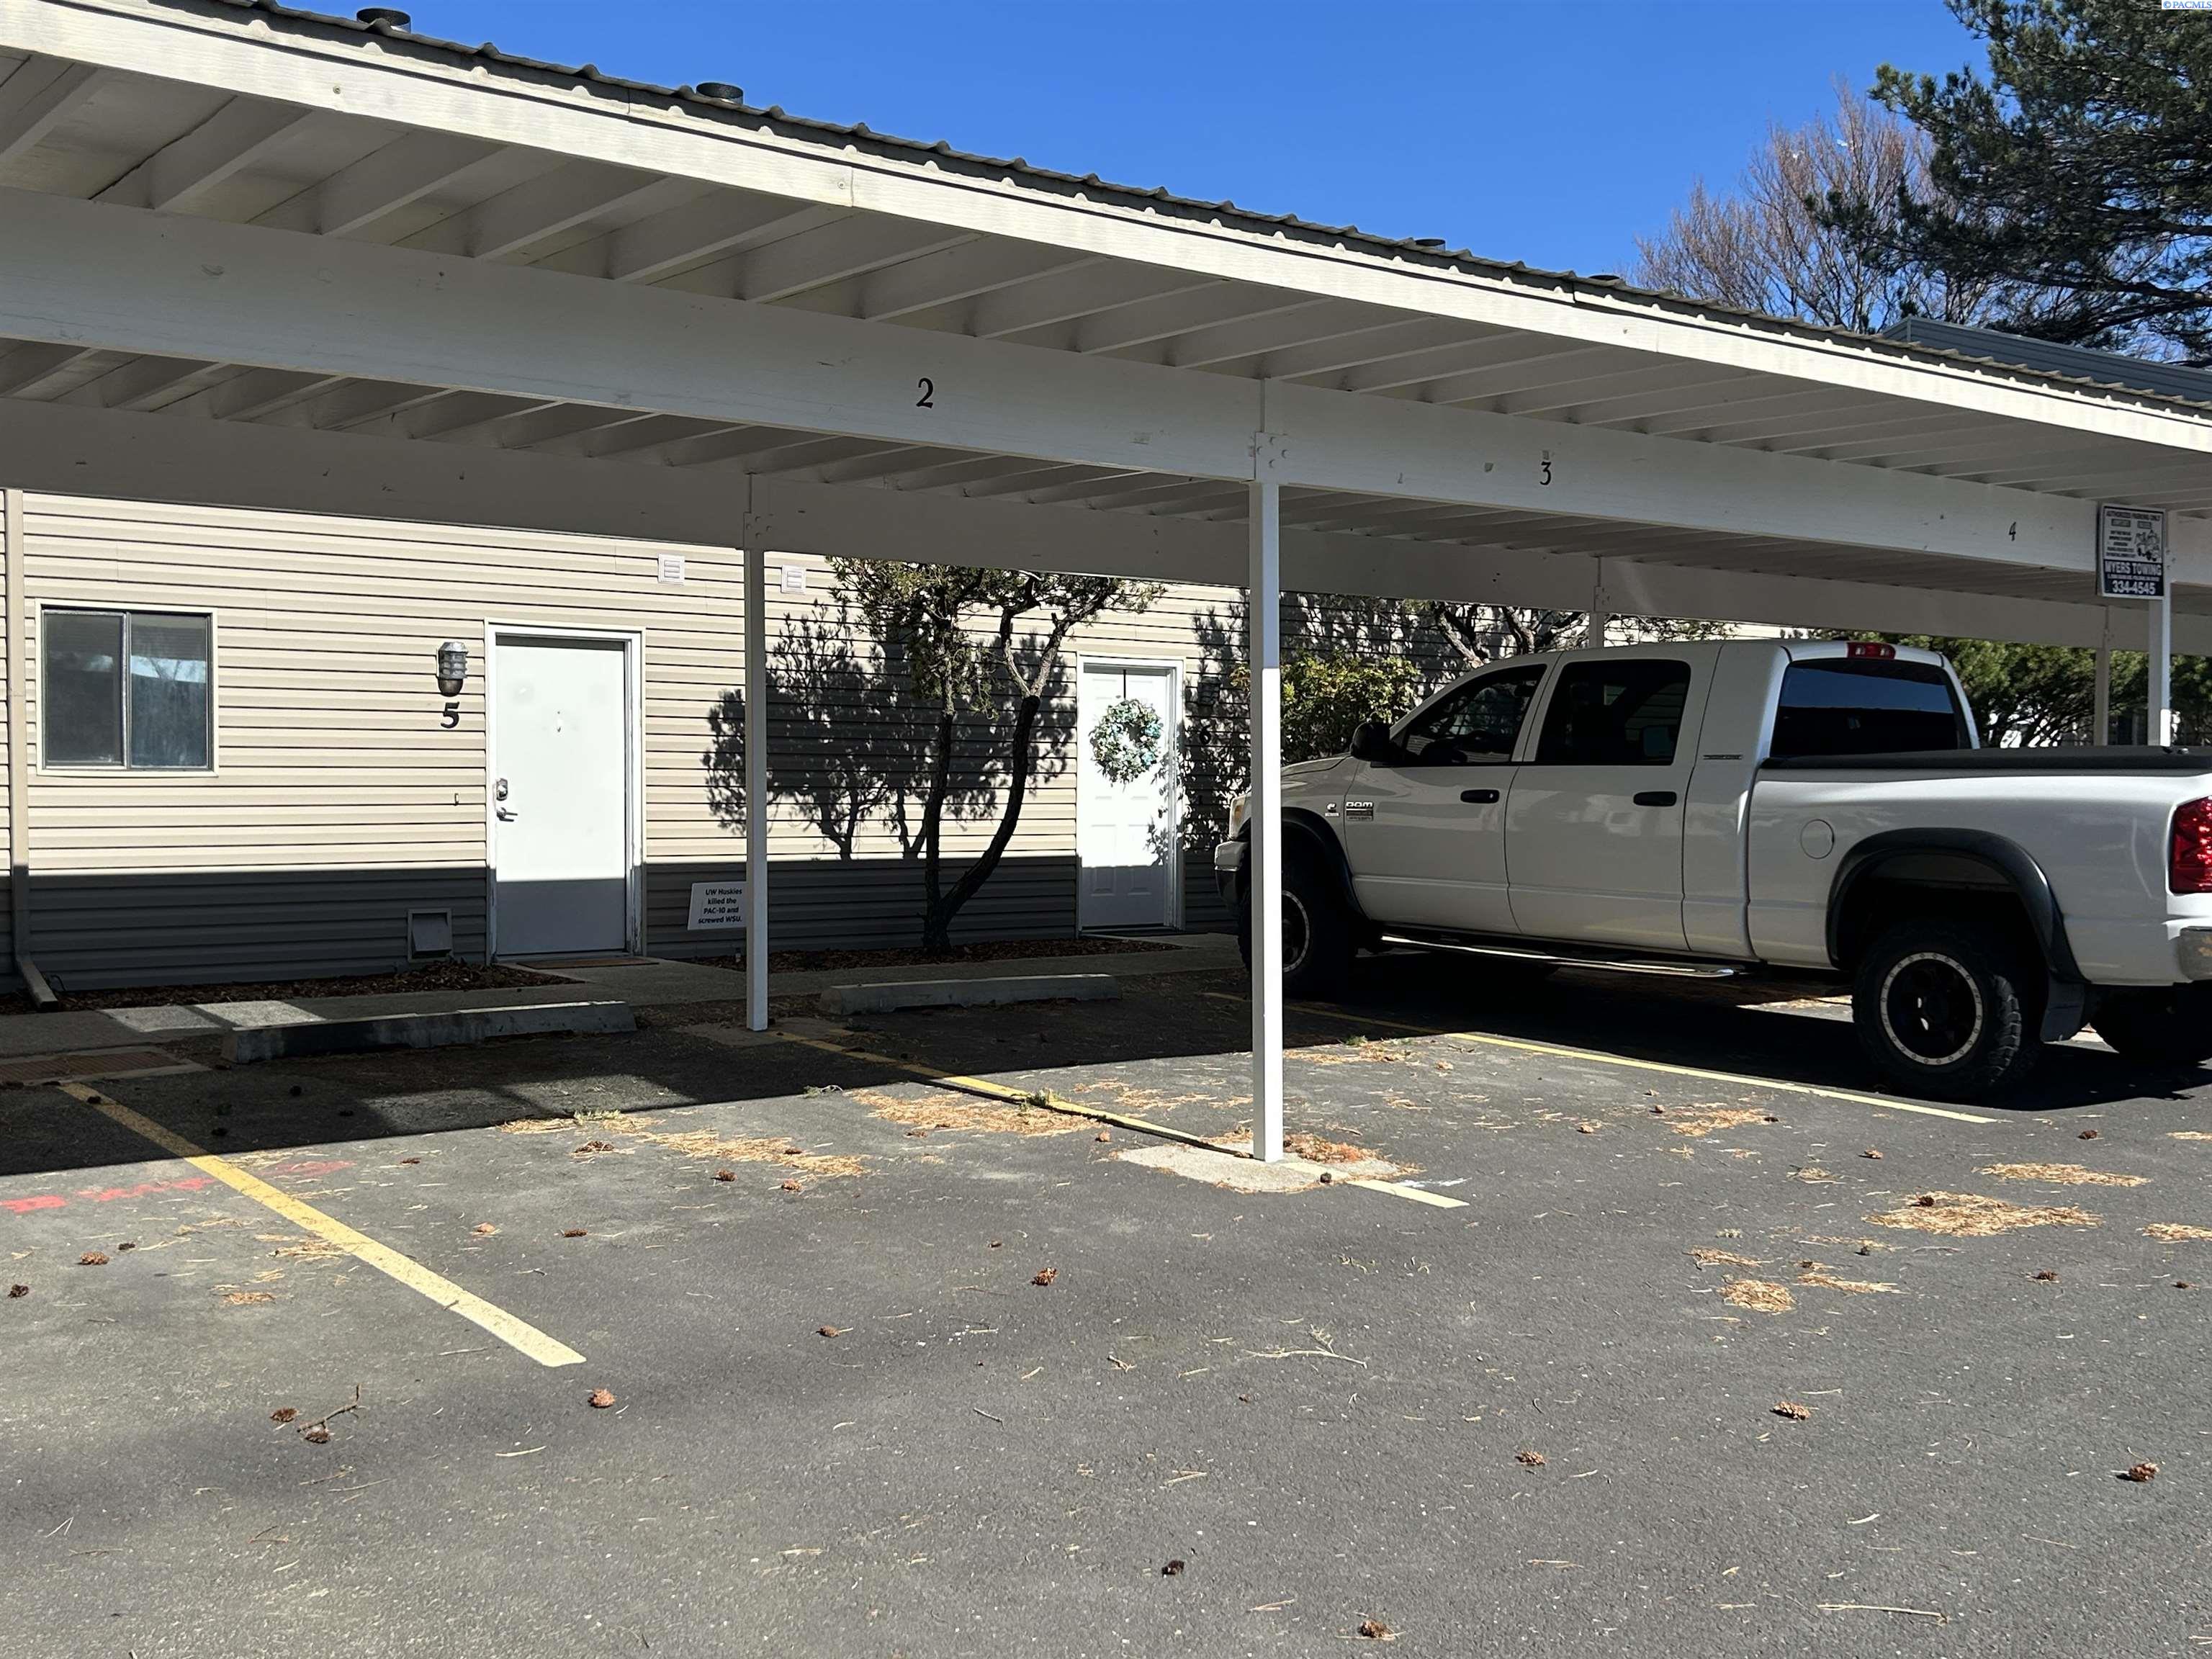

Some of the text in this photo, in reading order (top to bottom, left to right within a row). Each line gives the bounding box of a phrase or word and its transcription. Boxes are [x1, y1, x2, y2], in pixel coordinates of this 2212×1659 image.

[916, 377, 934, 409] 2
[1539, 461, 1552, 486] 3
[2008, 521, 2017, 542] 4
[2105, 561, 2162, 576] MYERS TOWING
[2112, 580, 2156, 595] 334-4545
[441, 701, 460, 729] 5
